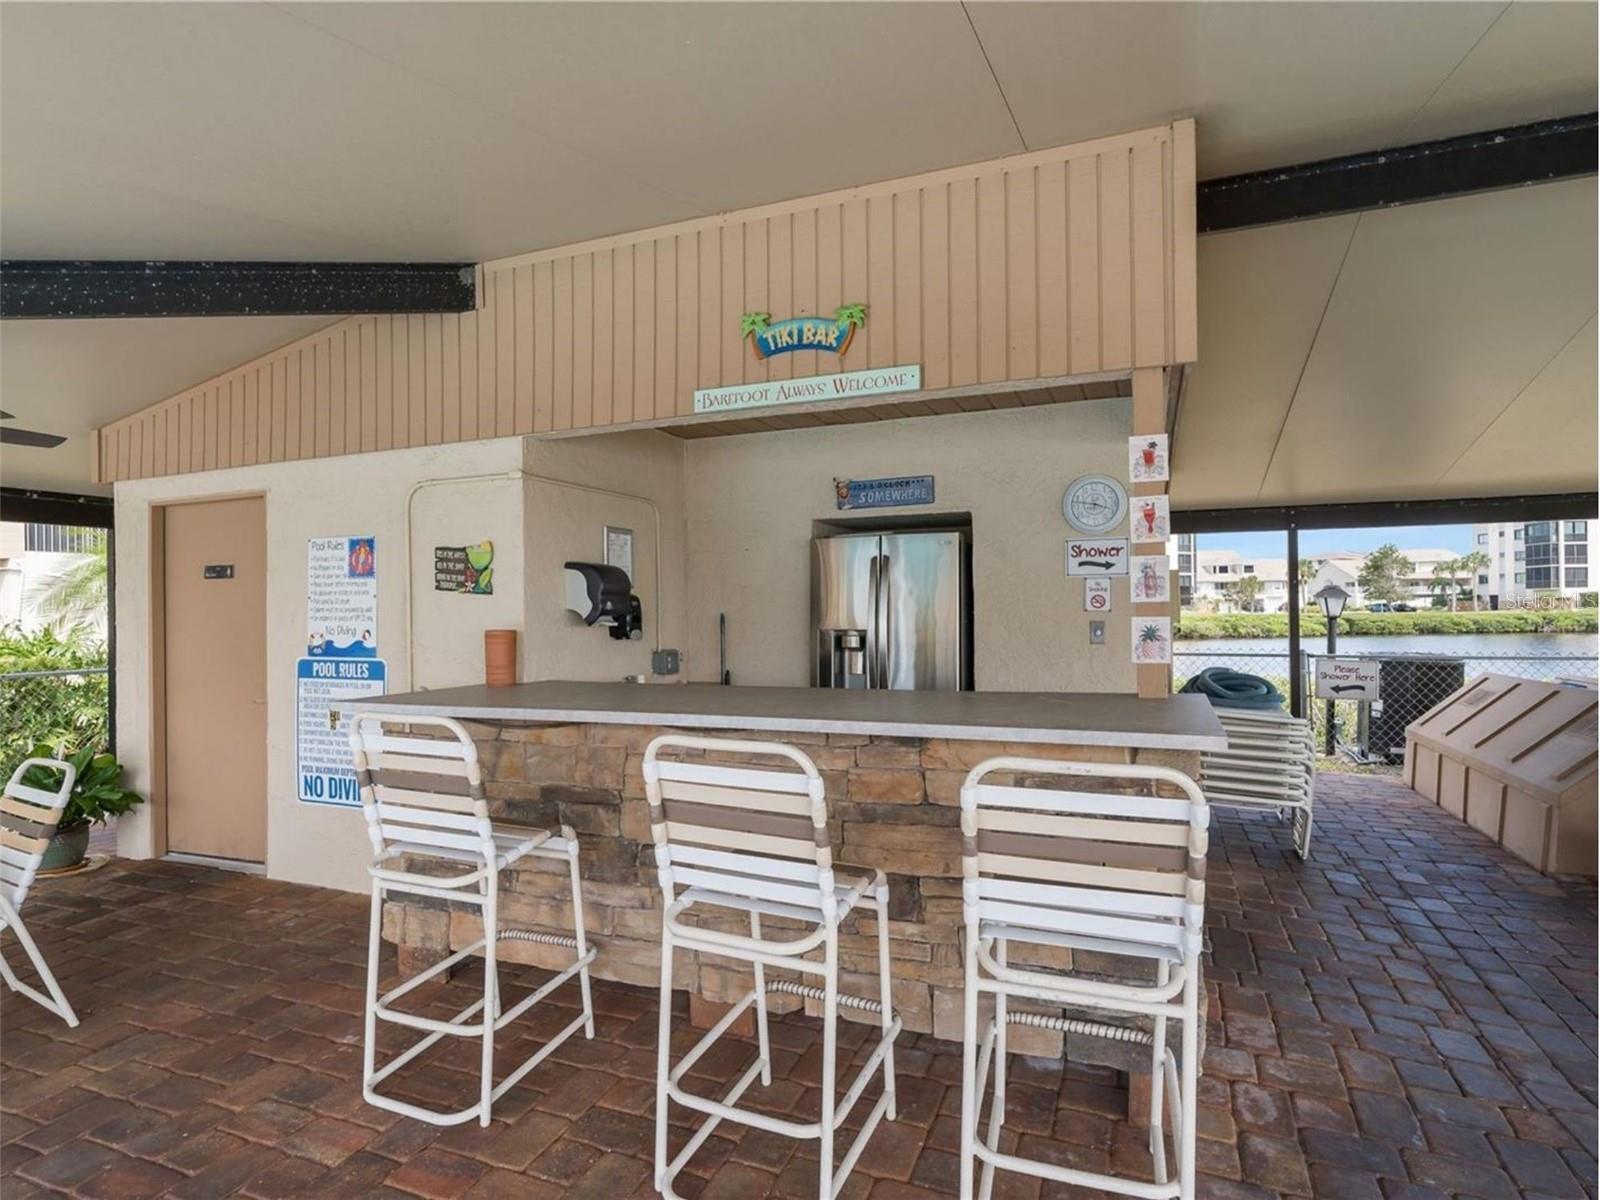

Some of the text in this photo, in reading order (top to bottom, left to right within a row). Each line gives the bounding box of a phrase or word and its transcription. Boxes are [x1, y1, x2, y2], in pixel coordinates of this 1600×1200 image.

[763, 323, 839, 350] TIKI BAR
[833, 373, 908, 394] WELCOME
[859, 488, 928, 503] SOMEWHERE
[1071, 544, 1124, 558] Shower
[312, 661, 369, 679] POOL RULES
[1334, 664, 1360, 673] Please
[1355, 672, 1375, 682] Here
[304, 775, 324, 798] NO
